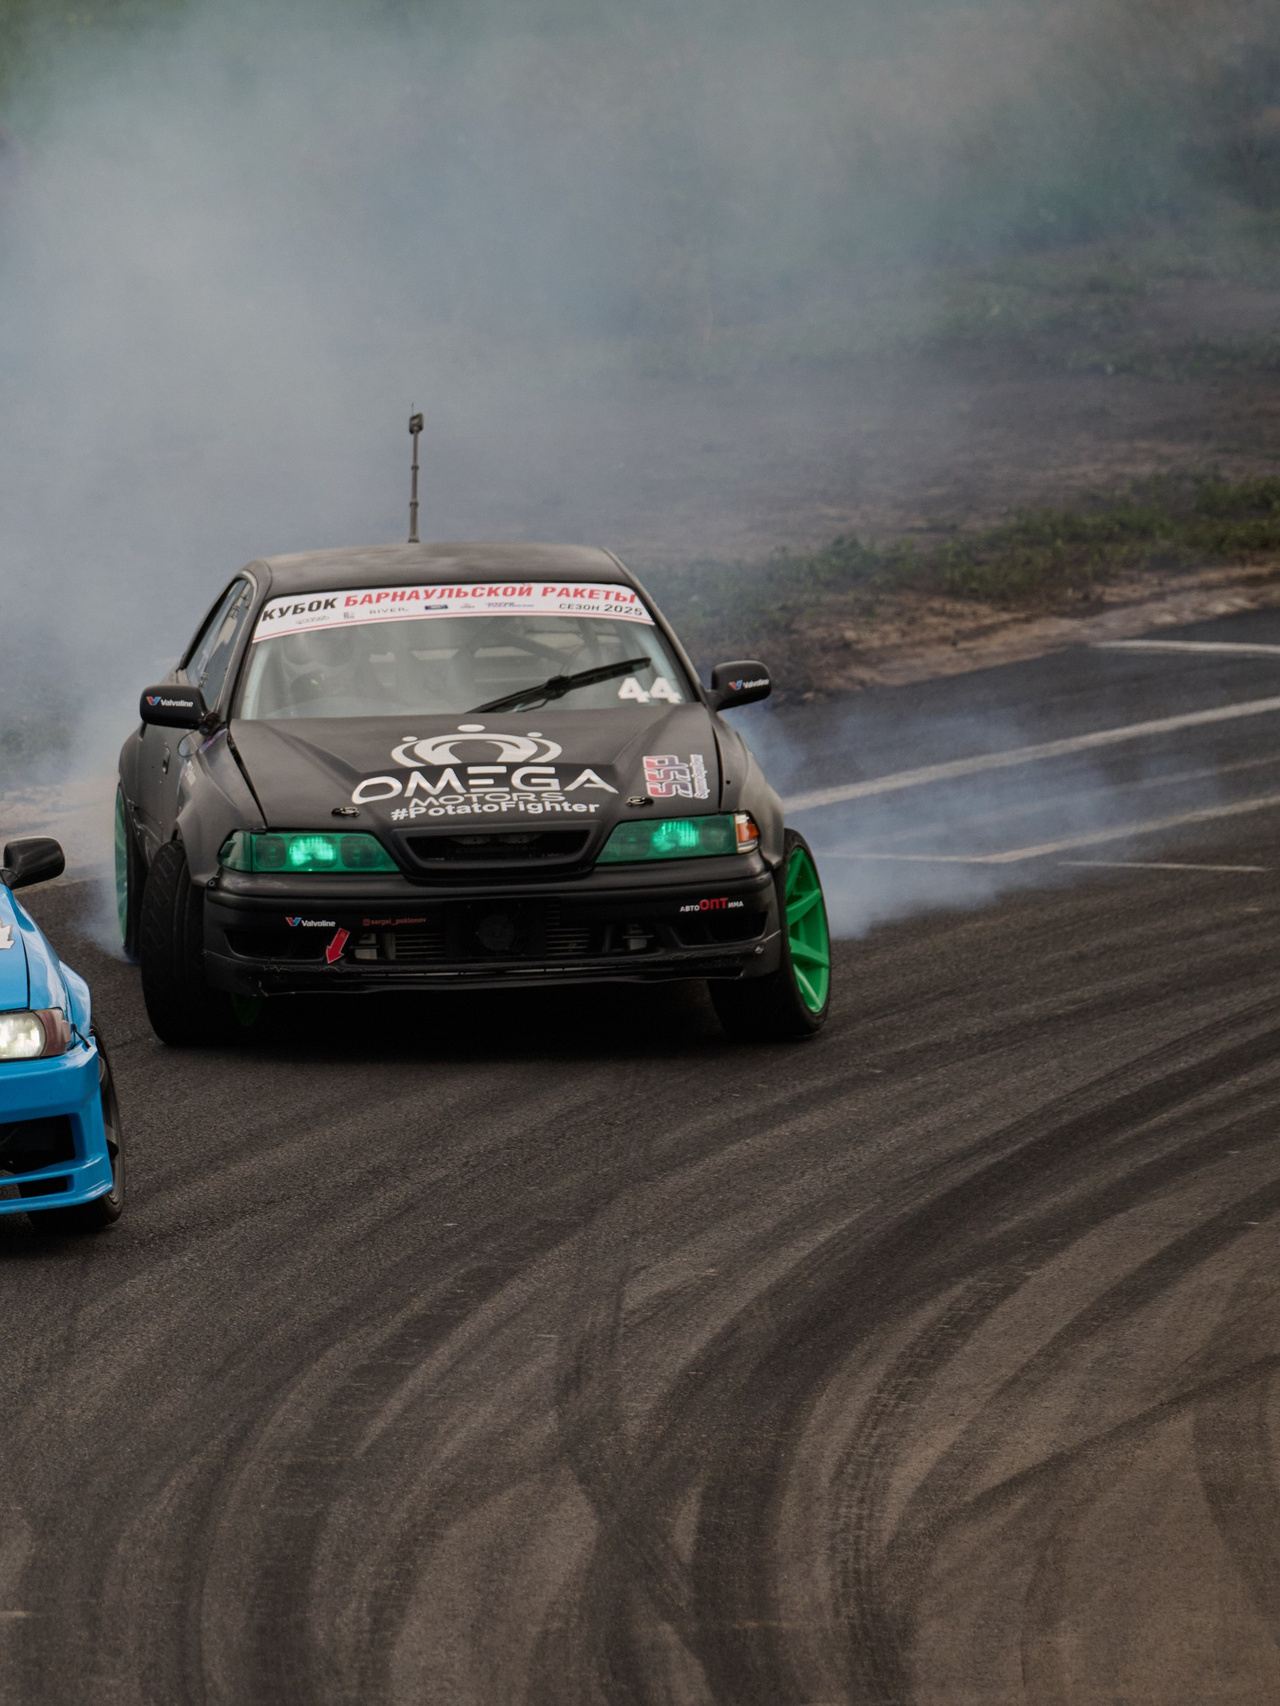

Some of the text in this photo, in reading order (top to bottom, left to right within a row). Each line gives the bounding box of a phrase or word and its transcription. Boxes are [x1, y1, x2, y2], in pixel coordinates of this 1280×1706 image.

[261, 597, 340, 622] КУБОК
[344, 584, 534, 607] БАРНАУЛЬСКОЙ
[541, 586, 638, 604] РАКЕТЫ
[559, 603, 644, 616] СЕЗОН 2025
[618, 677, 682, 703] 44
[160, 698, 194, 707] Valvoline
[351, 766, 620, 804] OMEGA
[409, 792, 567, 808] MOTORS
[391, 800, 601, 822] #PotatoFighter
[301, 919, 336, 928] Valvoline
